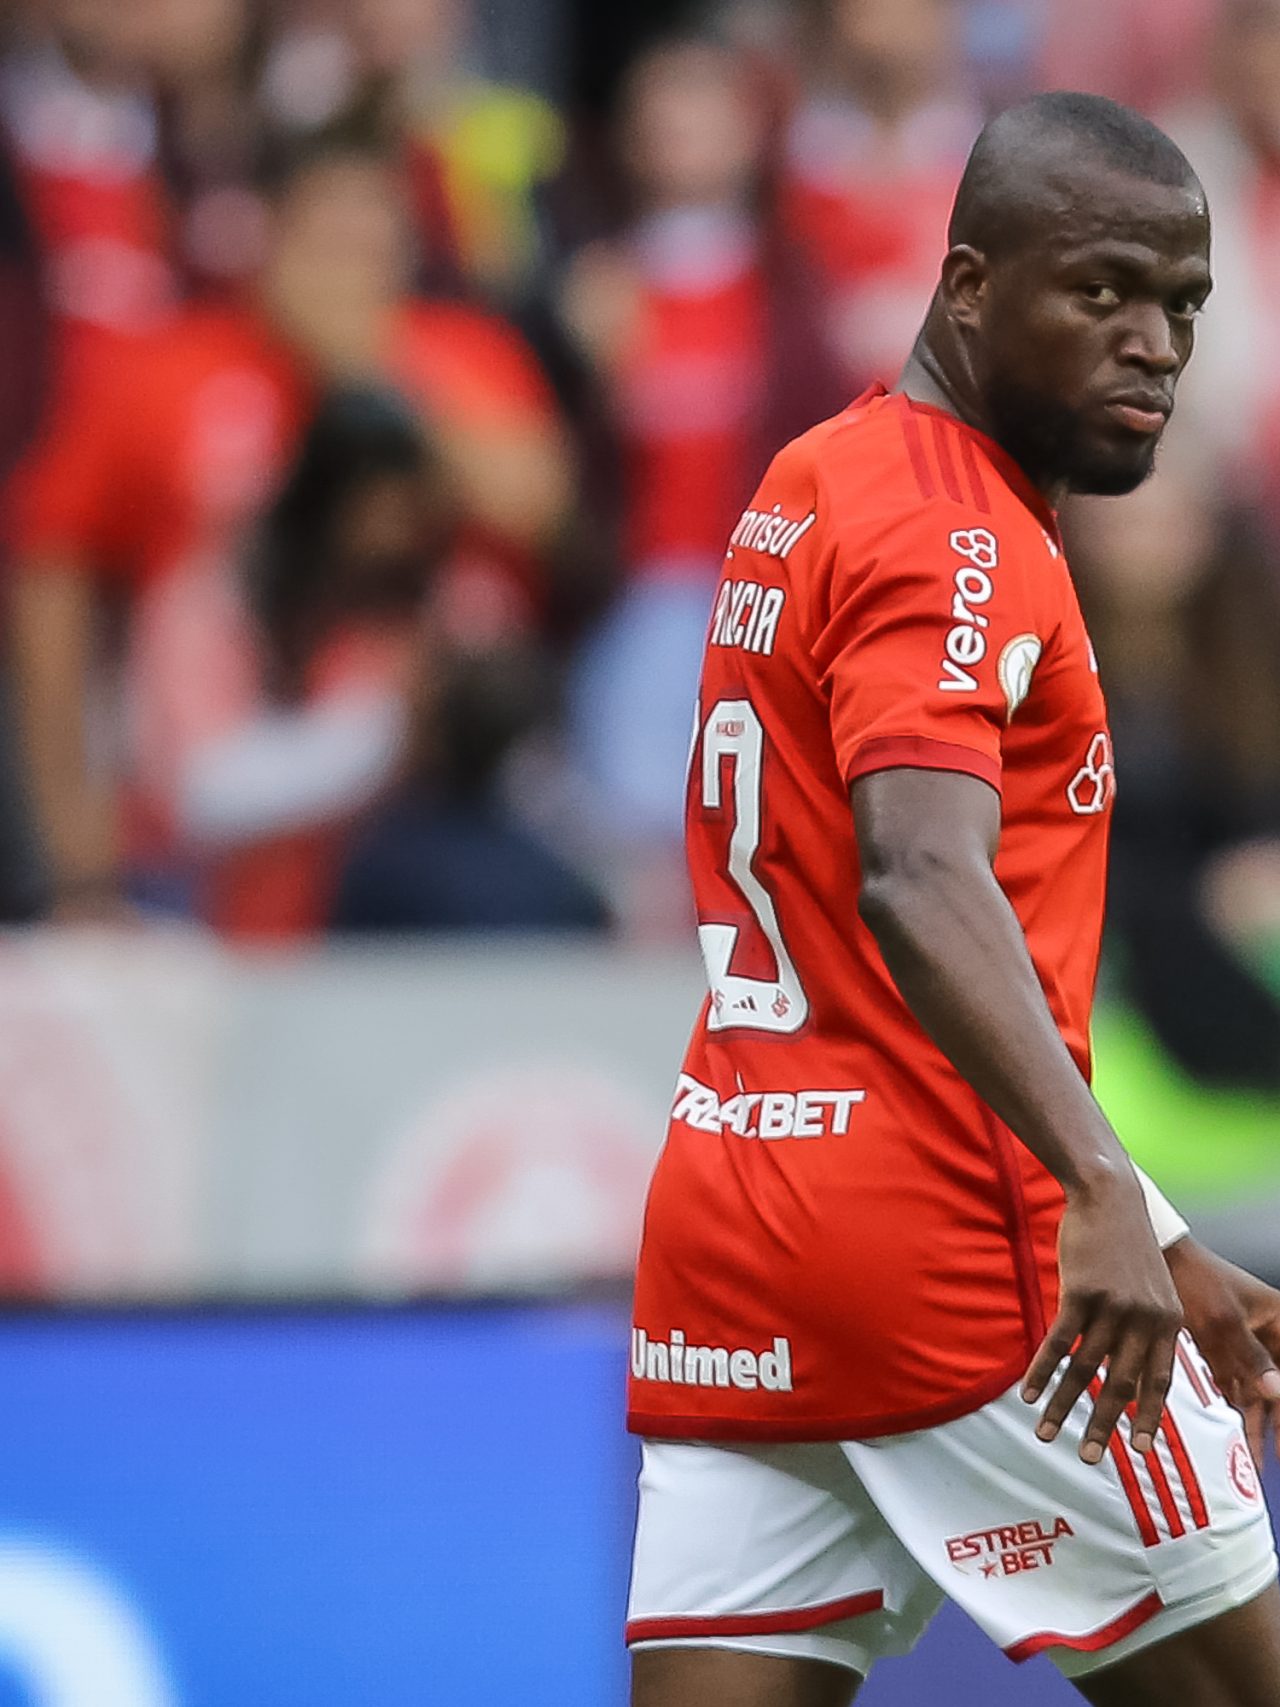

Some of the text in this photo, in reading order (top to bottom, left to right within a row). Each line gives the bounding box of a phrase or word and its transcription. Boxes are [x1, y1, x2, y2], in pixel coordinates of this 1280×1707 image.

[730, 503, 816, 560] nrisul
[938, 566, 994, 691] vero
[632, 1327, 793, 1392] Unimed
[945, 1517, 1074, 1561] ESTRELA
[1000, 1542, 1054, 1576] BET
